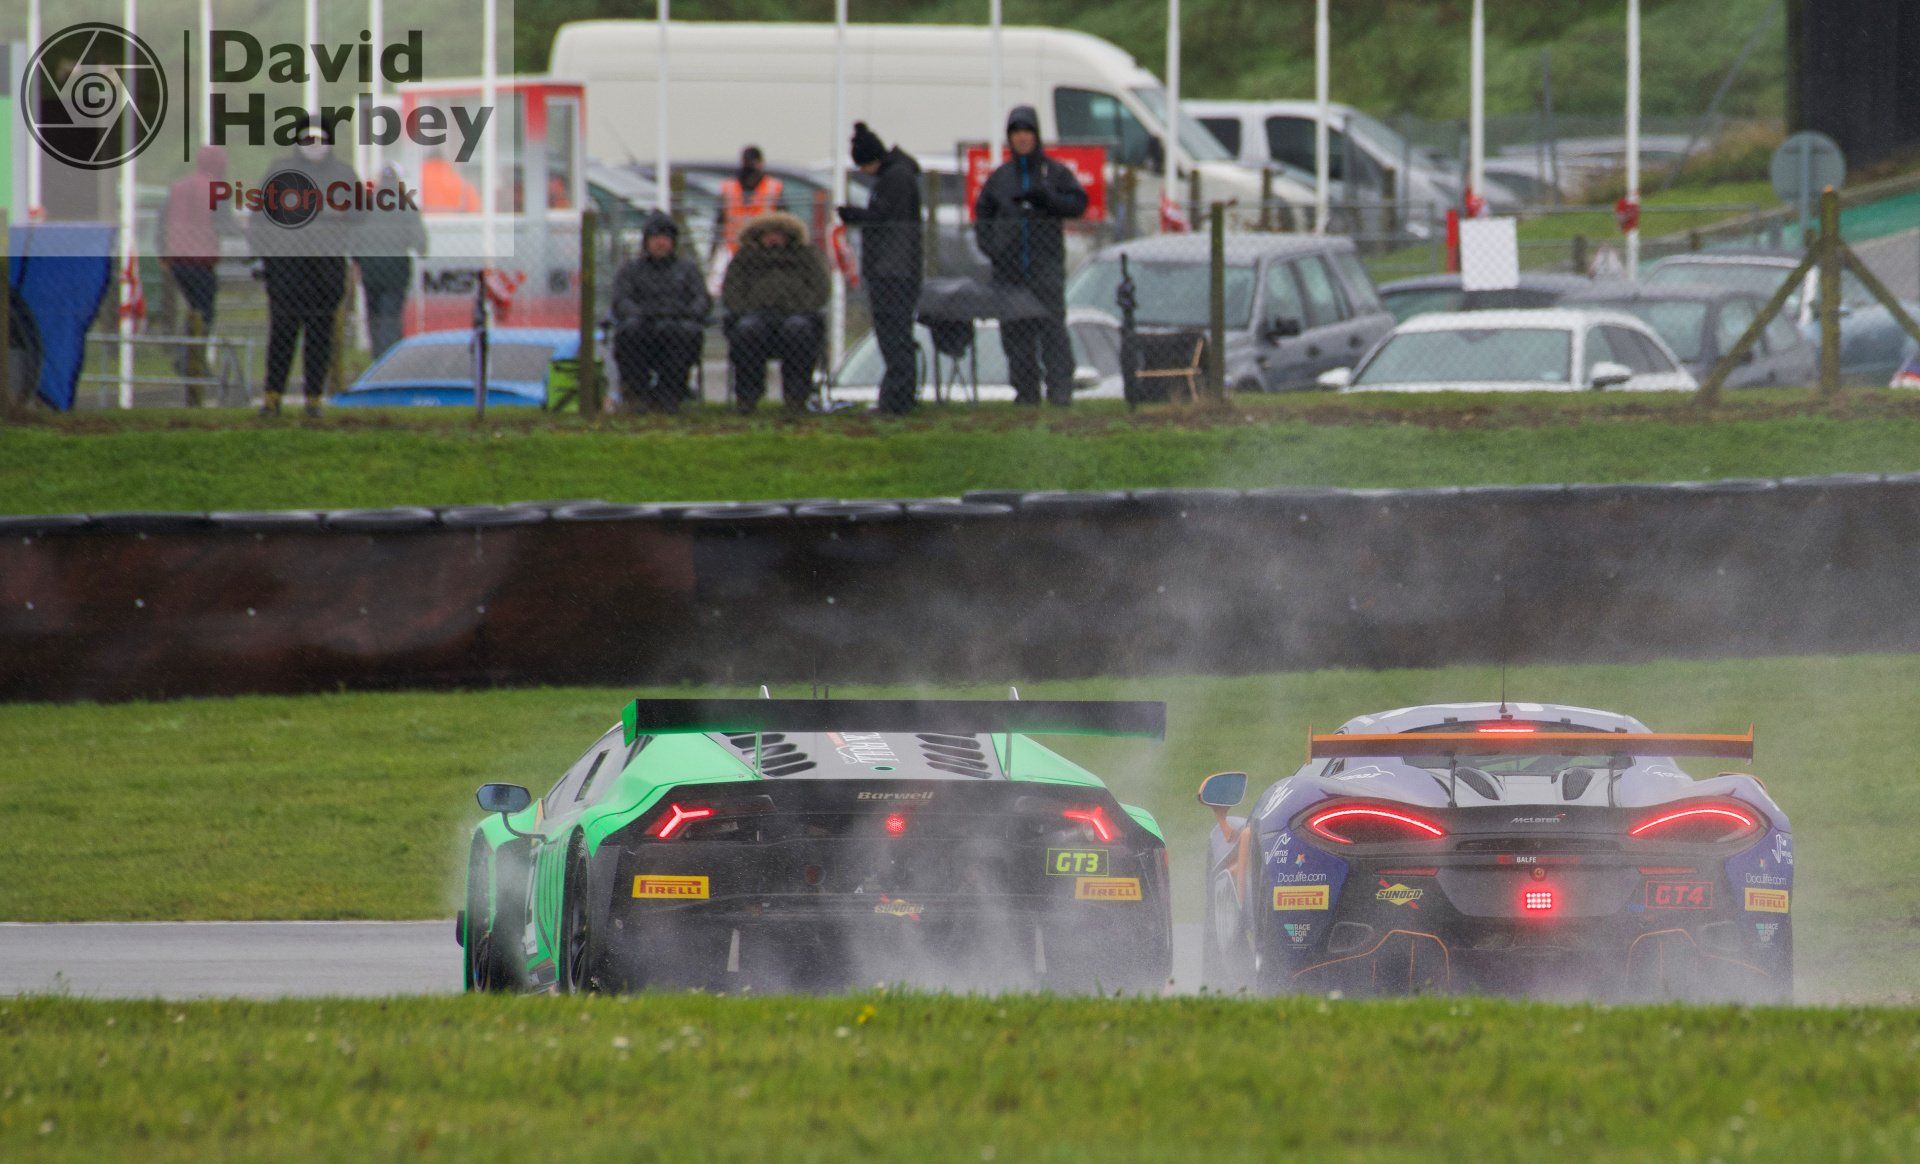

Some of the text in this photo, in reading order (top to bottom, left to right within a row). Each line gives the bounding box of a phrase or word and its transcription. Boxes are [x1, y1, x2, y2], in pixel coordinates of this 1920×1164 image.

[858, 791, 934, 800] Barwell
[1056, 852, 1099, 872] GT3
[1516, 856, 1537, 864] BALFE
[1277, 871, 1328, 883] Doculife.com
[639, 879, 703, 895] PIRELLI
[1082, 882, 1137, 897] PIRELLI
[1377, 889, 1422, 899] SUNOCO
[1656, 884, 1705, 905] GT4
[1277, 891, 1324, 906] PIRELLI
[1749, 892, 1786, 909] PIRELLI
